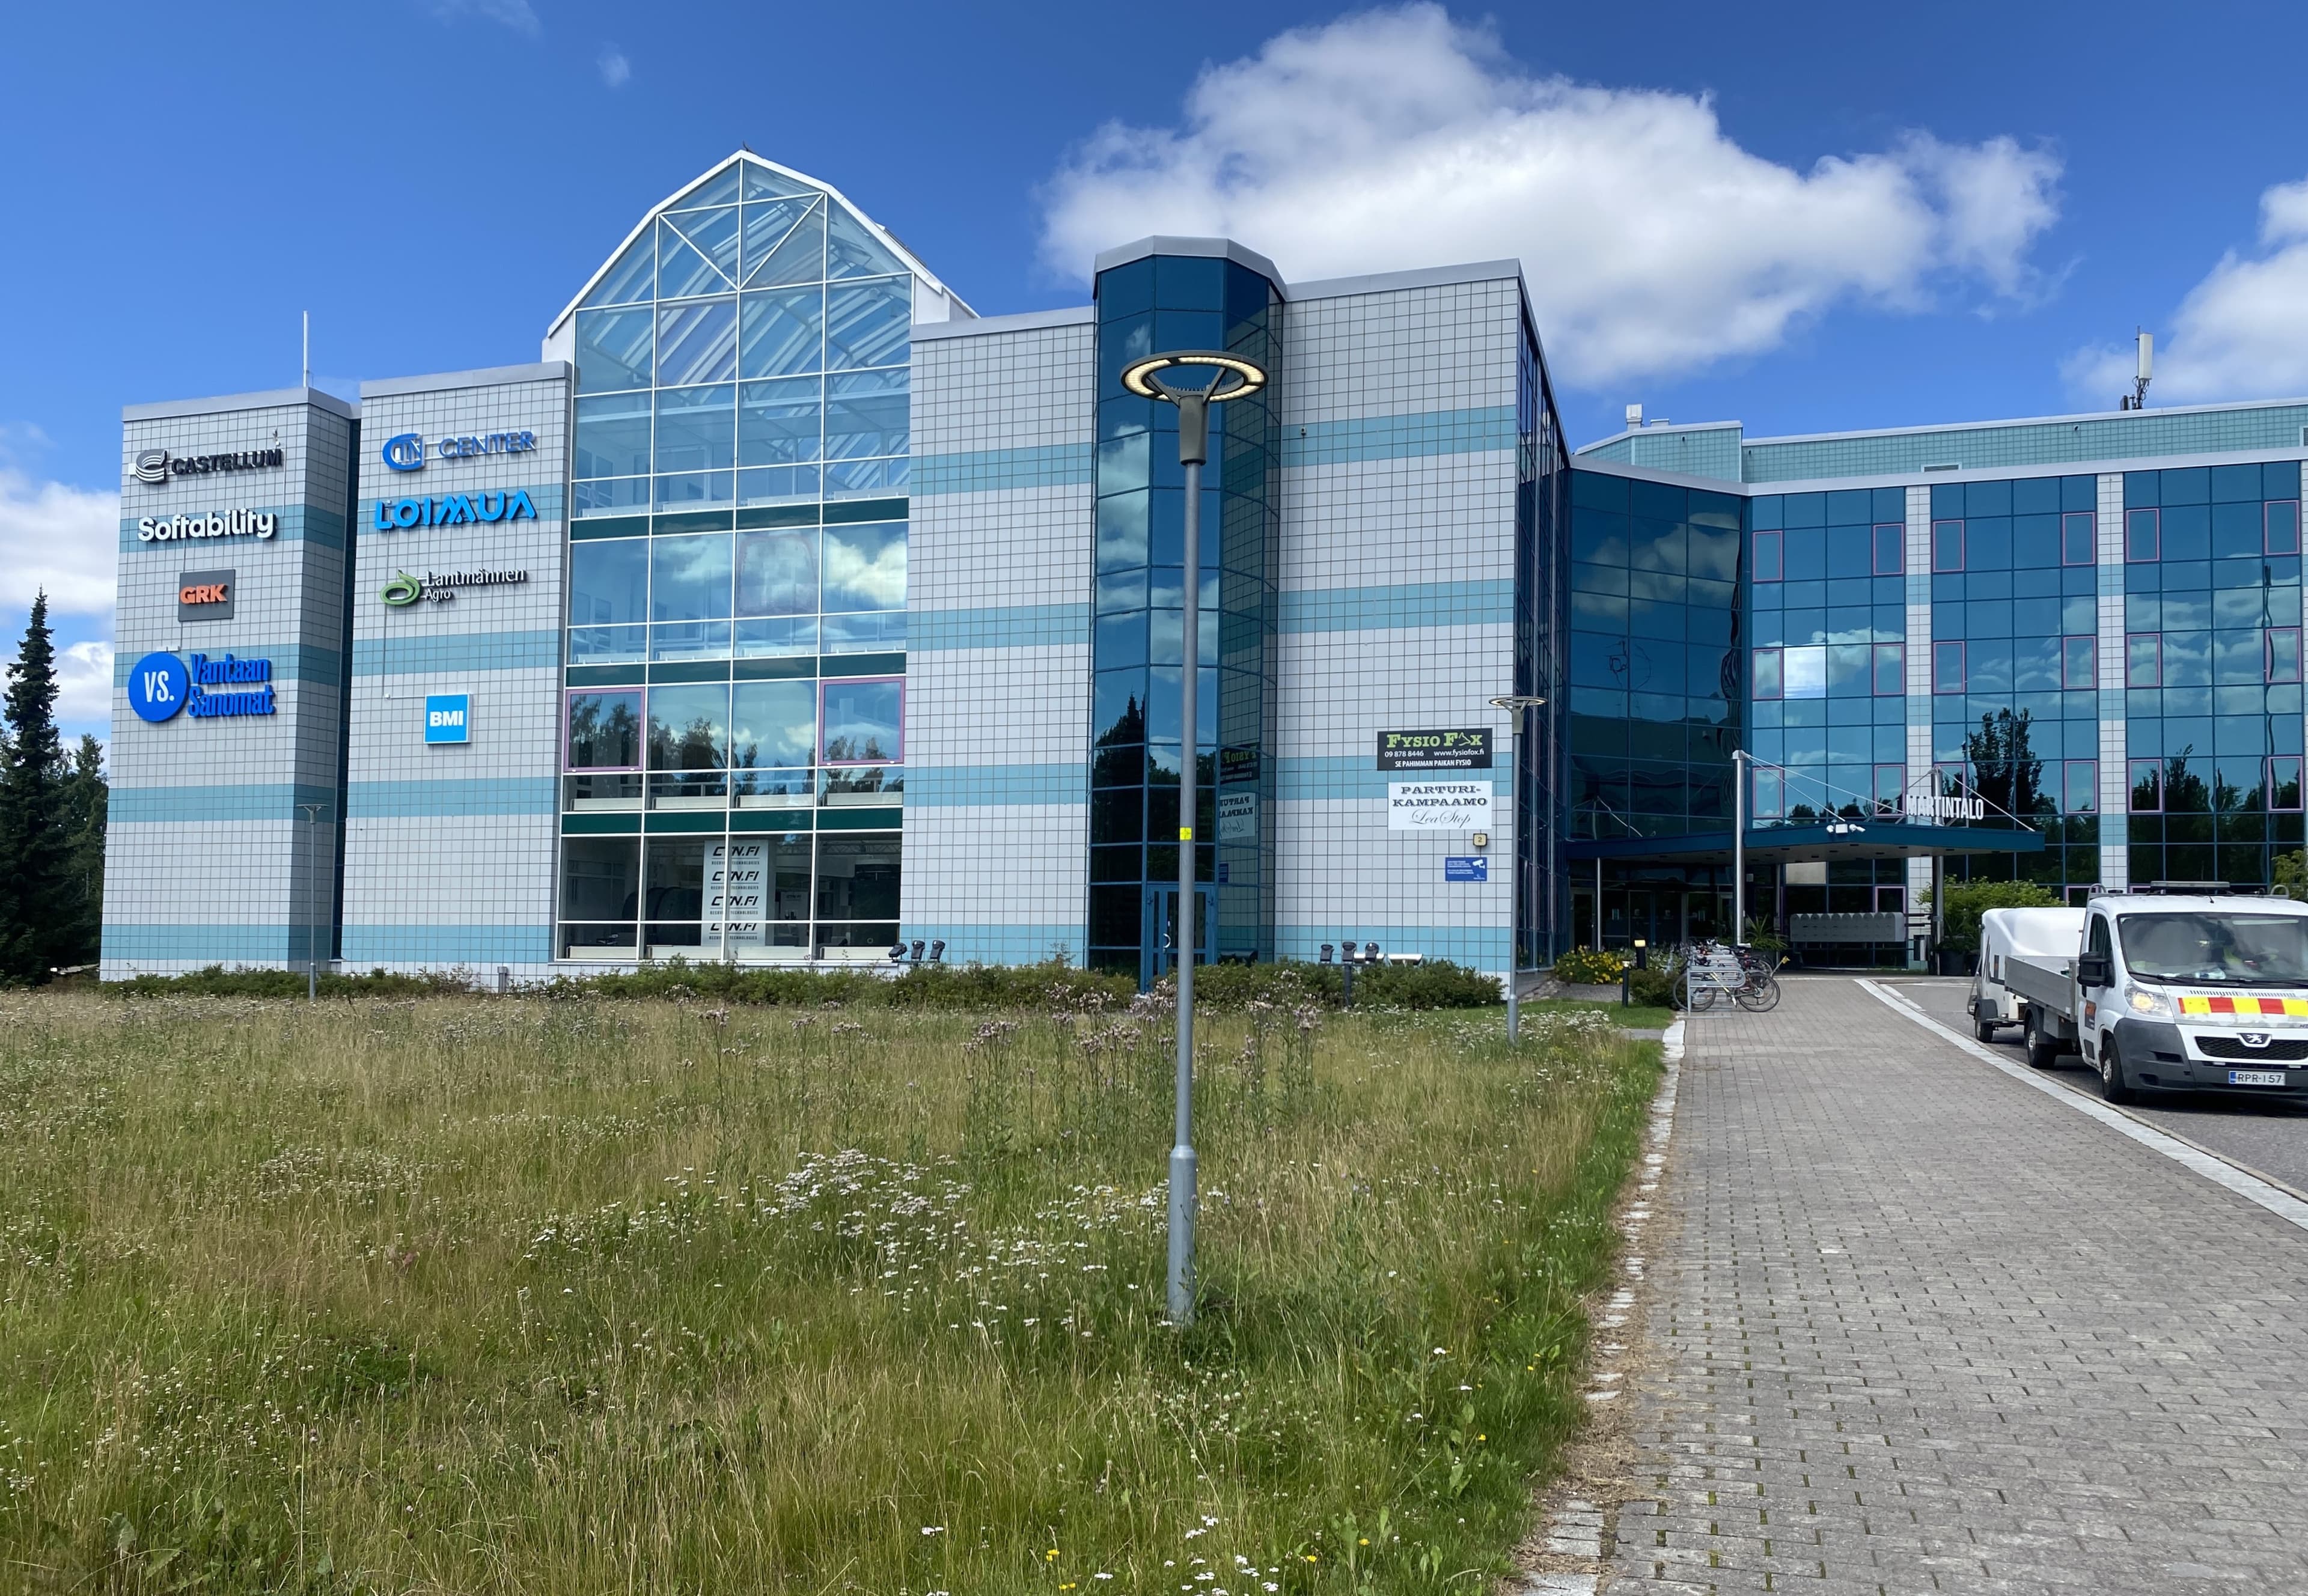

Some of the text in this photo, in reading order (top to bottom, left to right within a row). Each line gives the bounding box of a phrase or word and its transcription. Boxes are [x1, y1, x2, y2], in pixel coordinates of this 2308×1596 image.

[439, 431, 536, 458] CENTER
[171, 448, 282, 475] CASTELLUM
[374, 490, 537, 530] LOIMUA
[138, 507, 276, 542] Softability
[426, 567, 527, 588] Lantmännen
[180, 583, 228, 605] GRK
[424, 588, 451, 602] Agro
[190, 653, 272, 685] Vantaan
[144, 670, 175, 703] VS.
[188, 684, 276, 718] Sanomat
[429, 711, 463, 726] BMI
[1387, 734, 1441, 748] FYSIO
[1433, 748, 1485, 757] www.fysiofox.fi
[1400, 785, 1482, 795] PARTURI-
[1392, 797, 1488, 807] KAMPAAMO
[1906, 794, 1984, 820] MARTINTALO
[1409, 809, 1471, 829] Lea Stop
[713, 845, 760, 856] CN.FI
[712, 871, 759, 881] CN.FI
[711, 895, 759, 906] CN.FI
[2238, 1073, 2282, 1083] RPR-157
